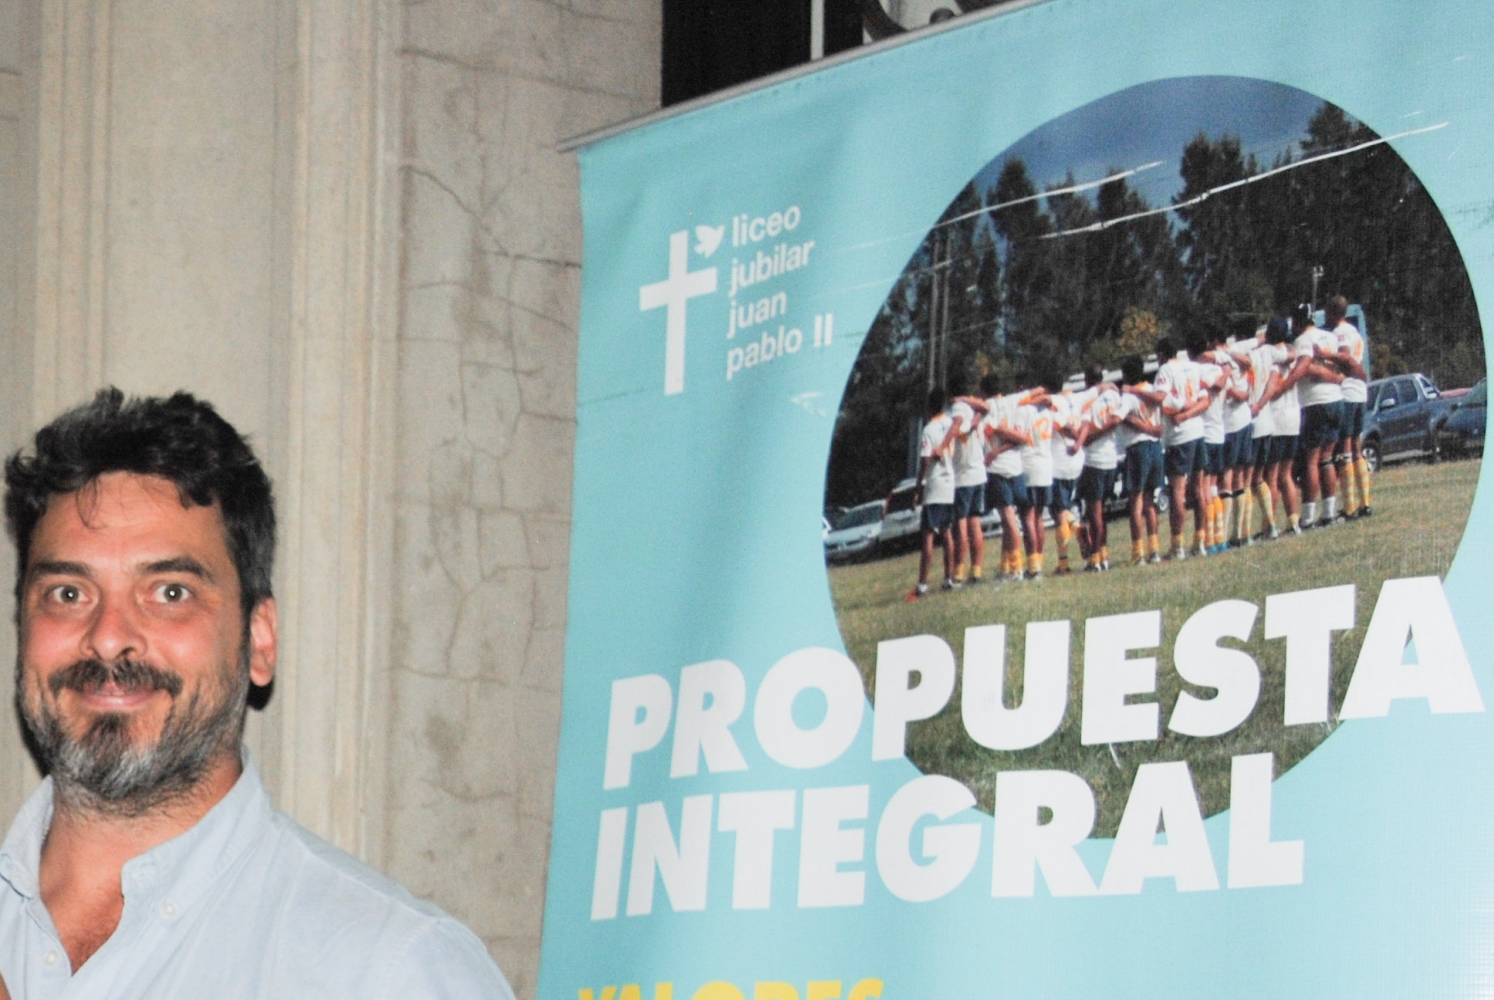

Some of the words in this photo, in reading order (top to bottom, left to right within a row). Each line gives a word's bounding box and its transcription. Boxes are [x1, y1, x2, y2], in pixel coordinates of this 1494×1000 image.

[732, 205, 801, 247] liceo
[728, 240, 816, 297] jubilar
[726, 291, 787, 339] juan
[726, 325, 803, 381] pablo
[813, 312, 834, 348] II
[602, 574, 1485, 790] PROPUESTA
[590, 752, 1304, 920] INTEGRAL
